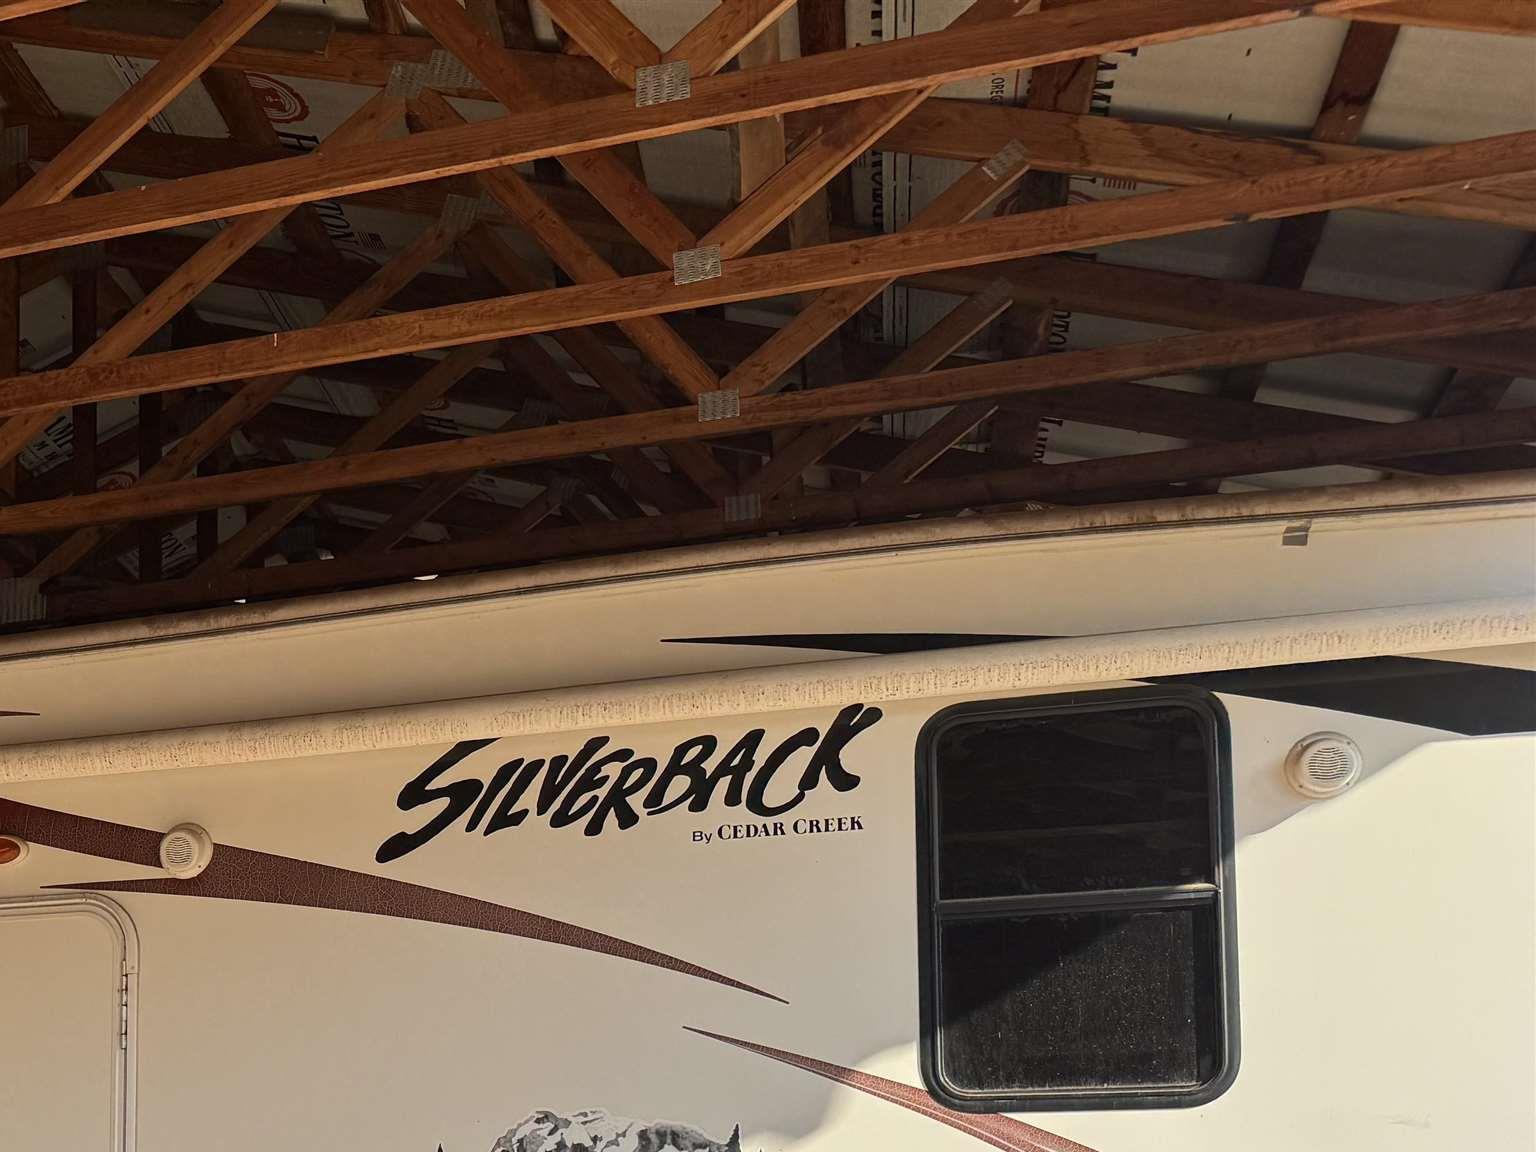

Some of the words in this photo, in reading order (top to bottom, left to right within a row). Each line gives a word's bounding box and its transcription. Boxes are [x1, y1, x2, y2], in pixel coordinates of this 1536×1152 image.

[374, 702, 884, 864] SILVERBACK
[691, 829, 713, 846] By
[717, 821, 786, 842] CEDAR
[792, 814, 864, 837] CREEK
